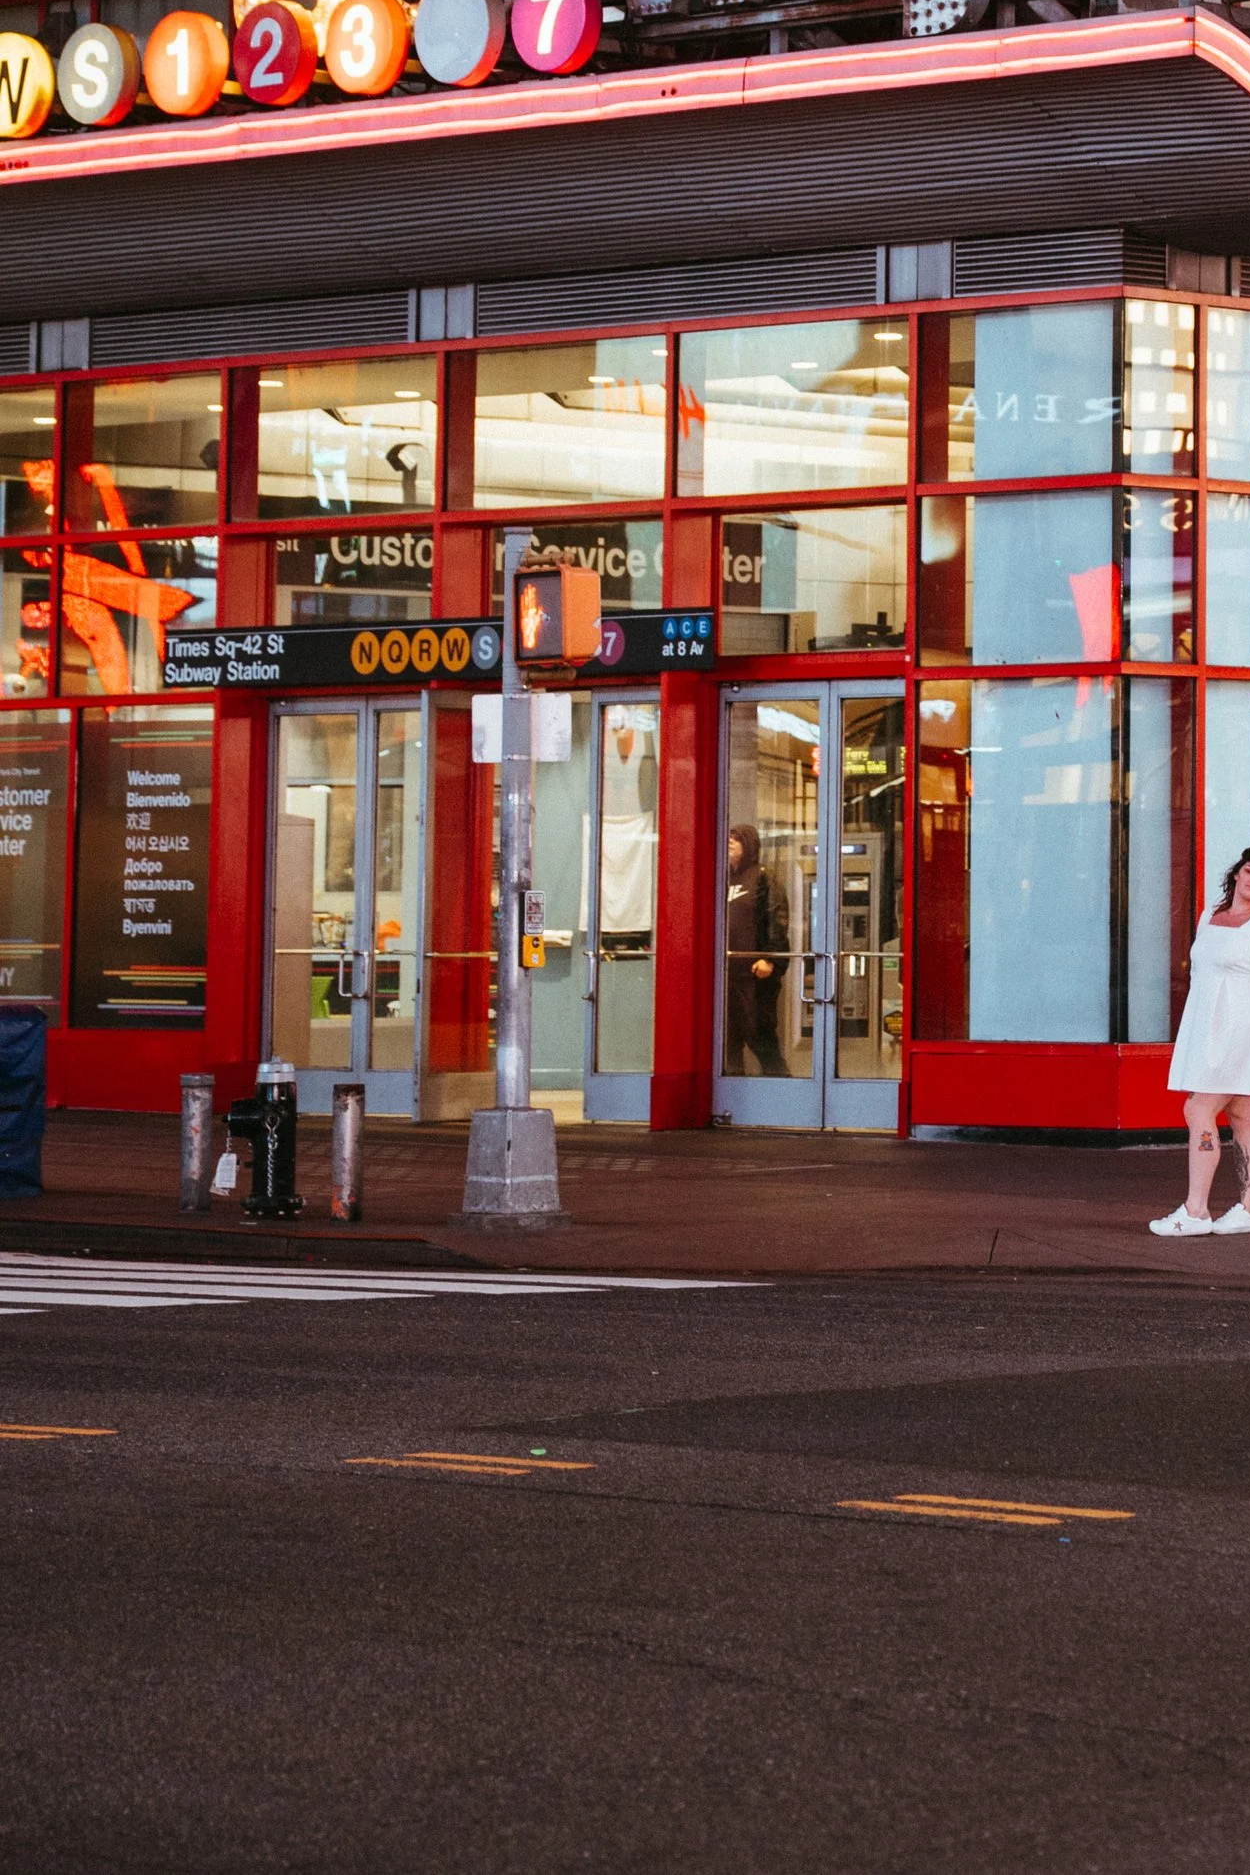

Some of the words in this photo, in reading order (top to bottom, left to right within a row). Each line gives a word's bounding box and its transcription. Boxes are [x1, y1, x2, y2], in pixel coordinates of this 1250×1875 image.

[0, 57, 29, 124] W
[71, 39, 110, 109] S
[166, 28, 190, 96] 1
[249, 17, 285, 89] 2
[339, 3, 377, 78] 3
[666, 622, 675, 635] A
[682, 621, 691, 634] C
[699, 620, 707, 633] E
[166, 637, 210, 658] Times
[215, 636, 262, 658] Sq-42
[267, 633, 285, 654] St
[359, 641, 373, 664] N
[388, 640, 403, 663] Q
[418, 639, 432, 662] R
[446, 637, 466, 662] W
[478, 635, 493, 660] S
[604, 632, 617, 657] 7
[662, 643, 674, 657] at
[678, 642, 686, 657] 8
[690, 641, 704, 656] Av
[165, 663, 222, 686] Subway
[227, 660, 280, 682] Station
[127, 770, 181, 786] Welcome
[126, 792, 191, 808] Bienvenido
[125, 836, 147, 853] 어서
[148, 836, 190, 852] 오십시오
[123, 858, 163, 877] Добро
[124, 879, 195, 892] пожаловать
[122, 919, 172, 937] Byenvini
